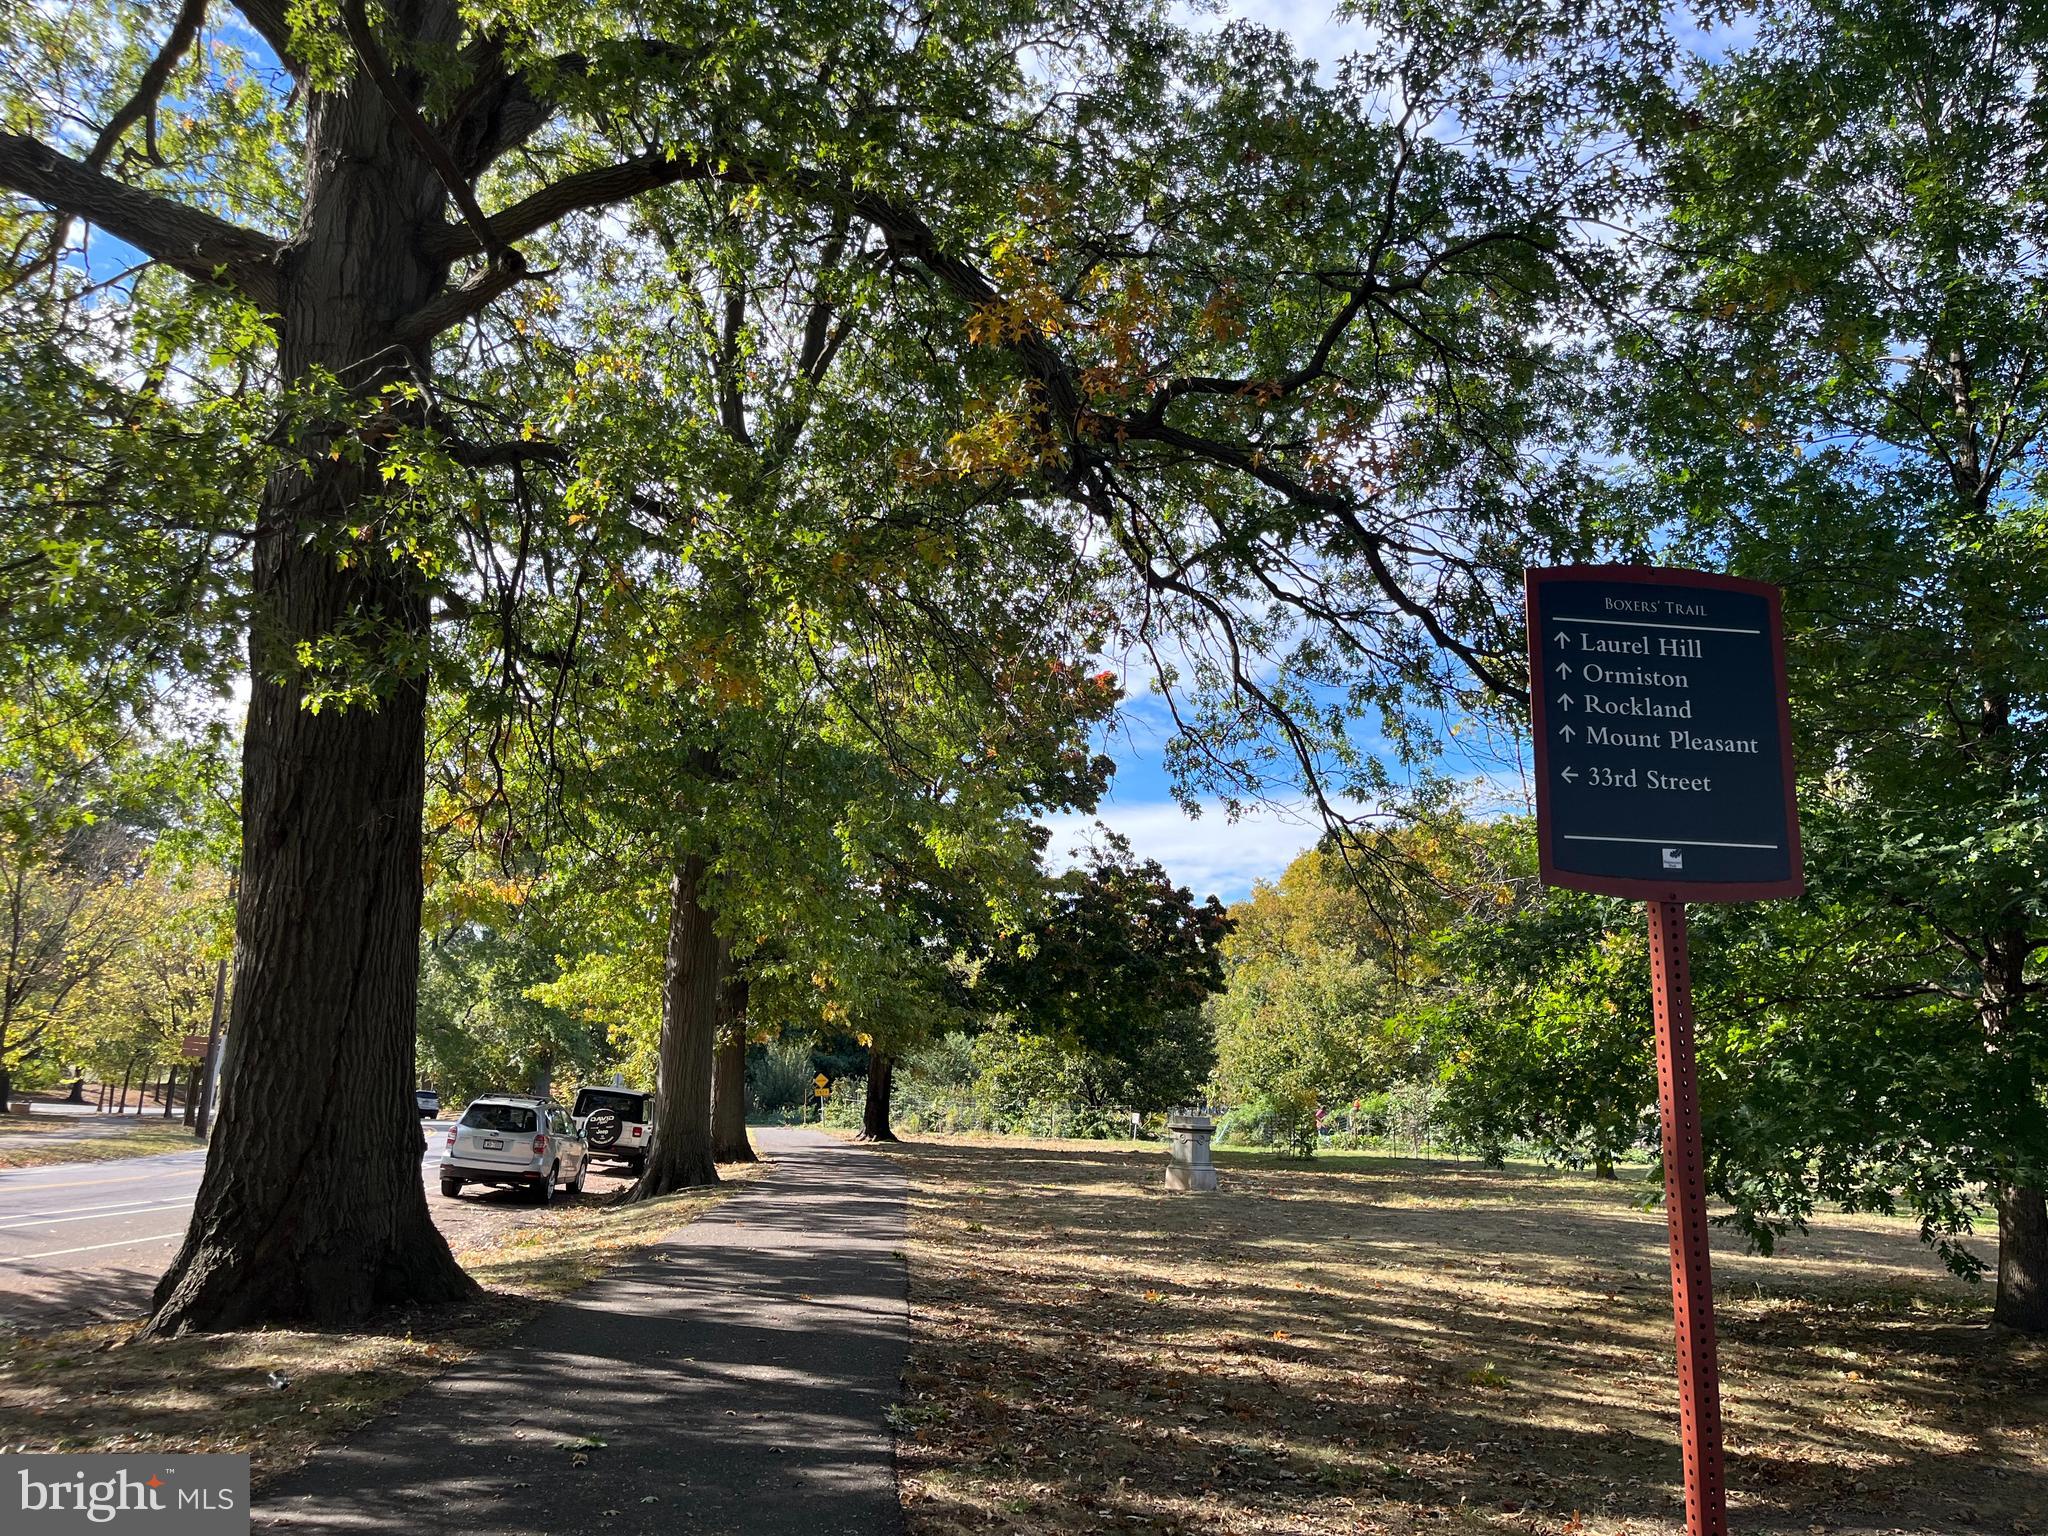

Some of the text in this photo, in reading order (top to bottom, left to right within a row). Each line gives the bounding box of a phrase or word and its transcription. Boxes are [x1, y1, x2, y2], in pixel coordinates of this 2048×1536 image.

[1665, 601, 1708, 616] TRAIL
[1579, 632, 1703, 658] Laurel Hill
[1583, 663, 1689, 688] Ormiston
[1584, 694, 1693, 719] Rockland
[1586, 726, 1759, 753] Mount Pleasant
[1588, 767, 1712, 791] 33rd Street
